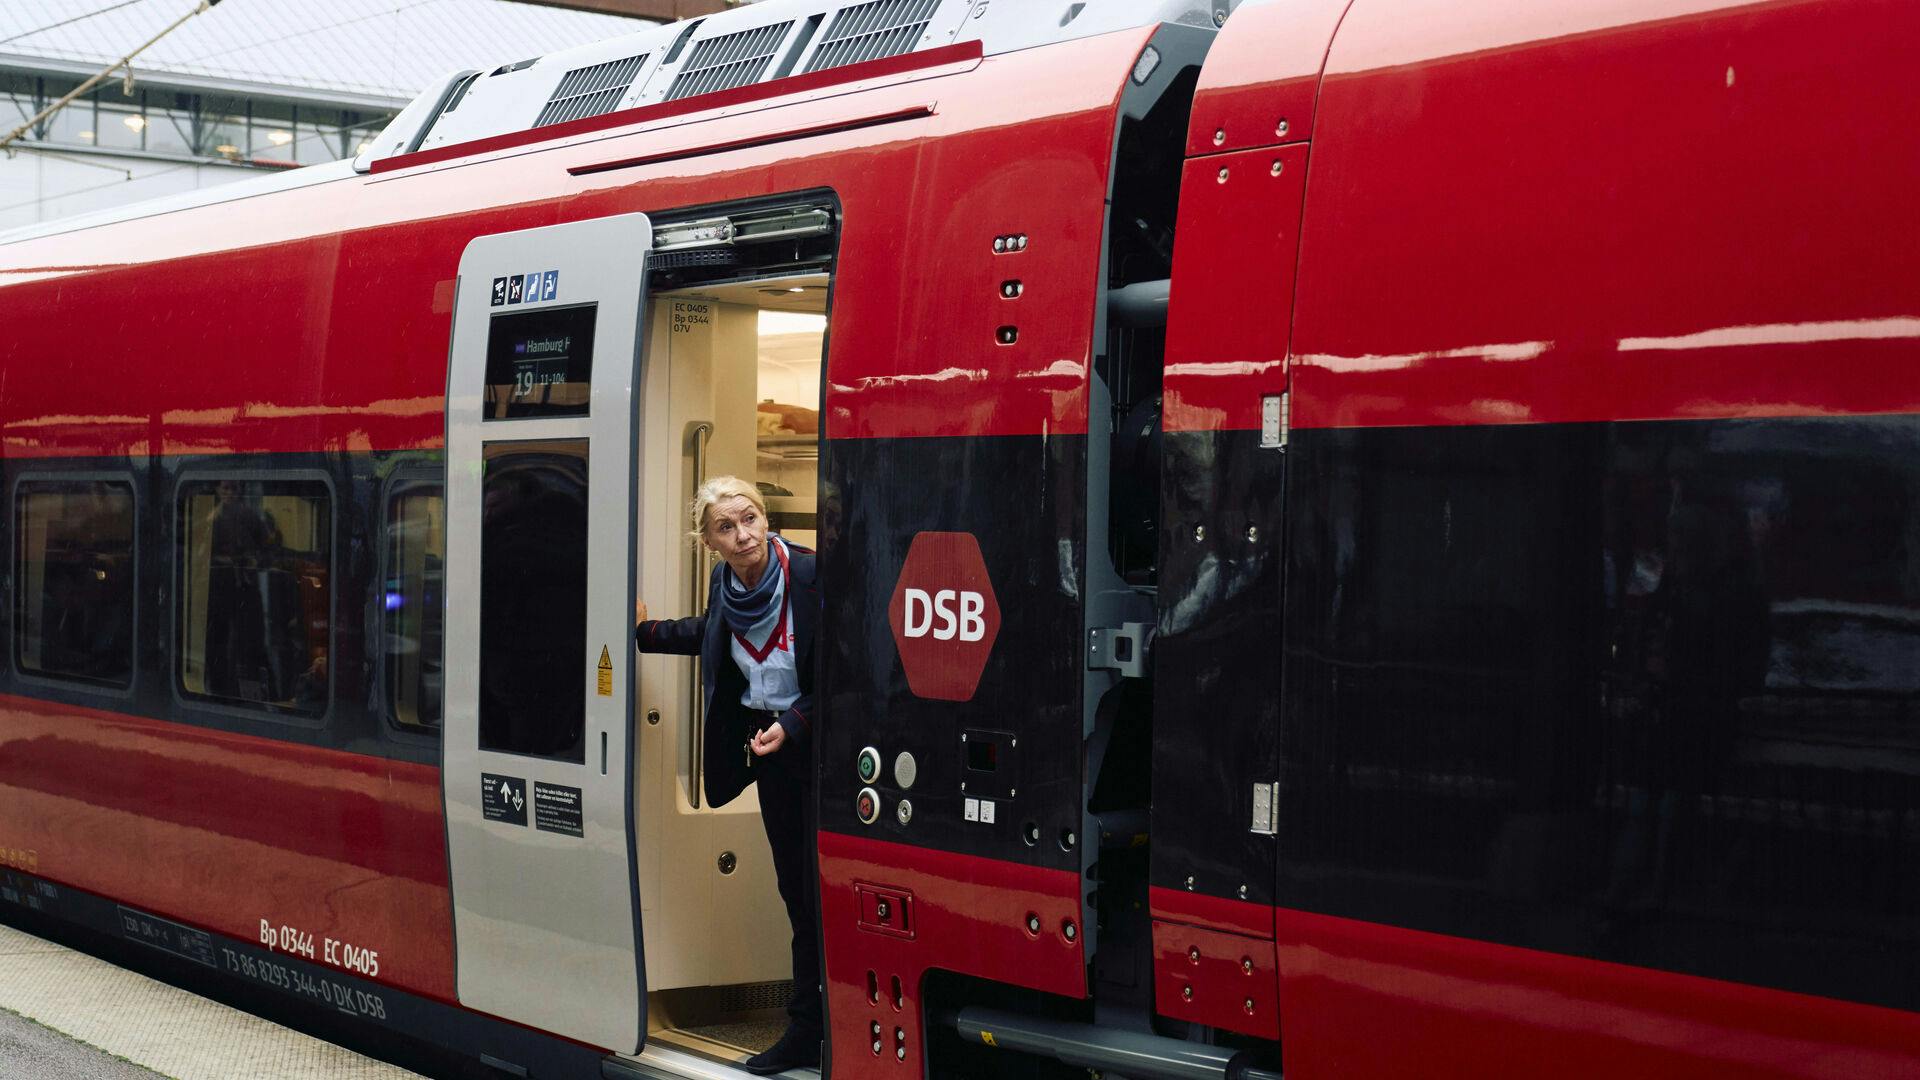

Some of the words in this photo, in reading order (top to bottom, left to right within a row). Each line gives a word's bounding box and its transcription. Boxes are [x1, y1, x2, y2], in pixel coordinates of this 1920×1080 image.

[675, 303, 685, 312] EC
[687, 304, 708, 313] 0405
[674, 314, 685, 323] Bp
[688, 315, 709, 324] 0344
[674, 324, 691, 333] 07V
[526, 338, 563, 353] Hamburg
[515, 371, 533, 396] 19
[904, 588, 985, 642] DSB
[260, 918, 277, 951] Bp
[280, 925, 315, 959] 0344
[324, 938, 341, 966] EC
[343, 944, 379, 977] 0405
[222, 948, 239, 972] 73
[240, 954, 257, 978] 86
[258, 960, 290, 989] 8293
[291, 970, 331, 1002] 344-0
[332, 983, 357, 1013] DK
[356, 990, 386, 1020] DSB
